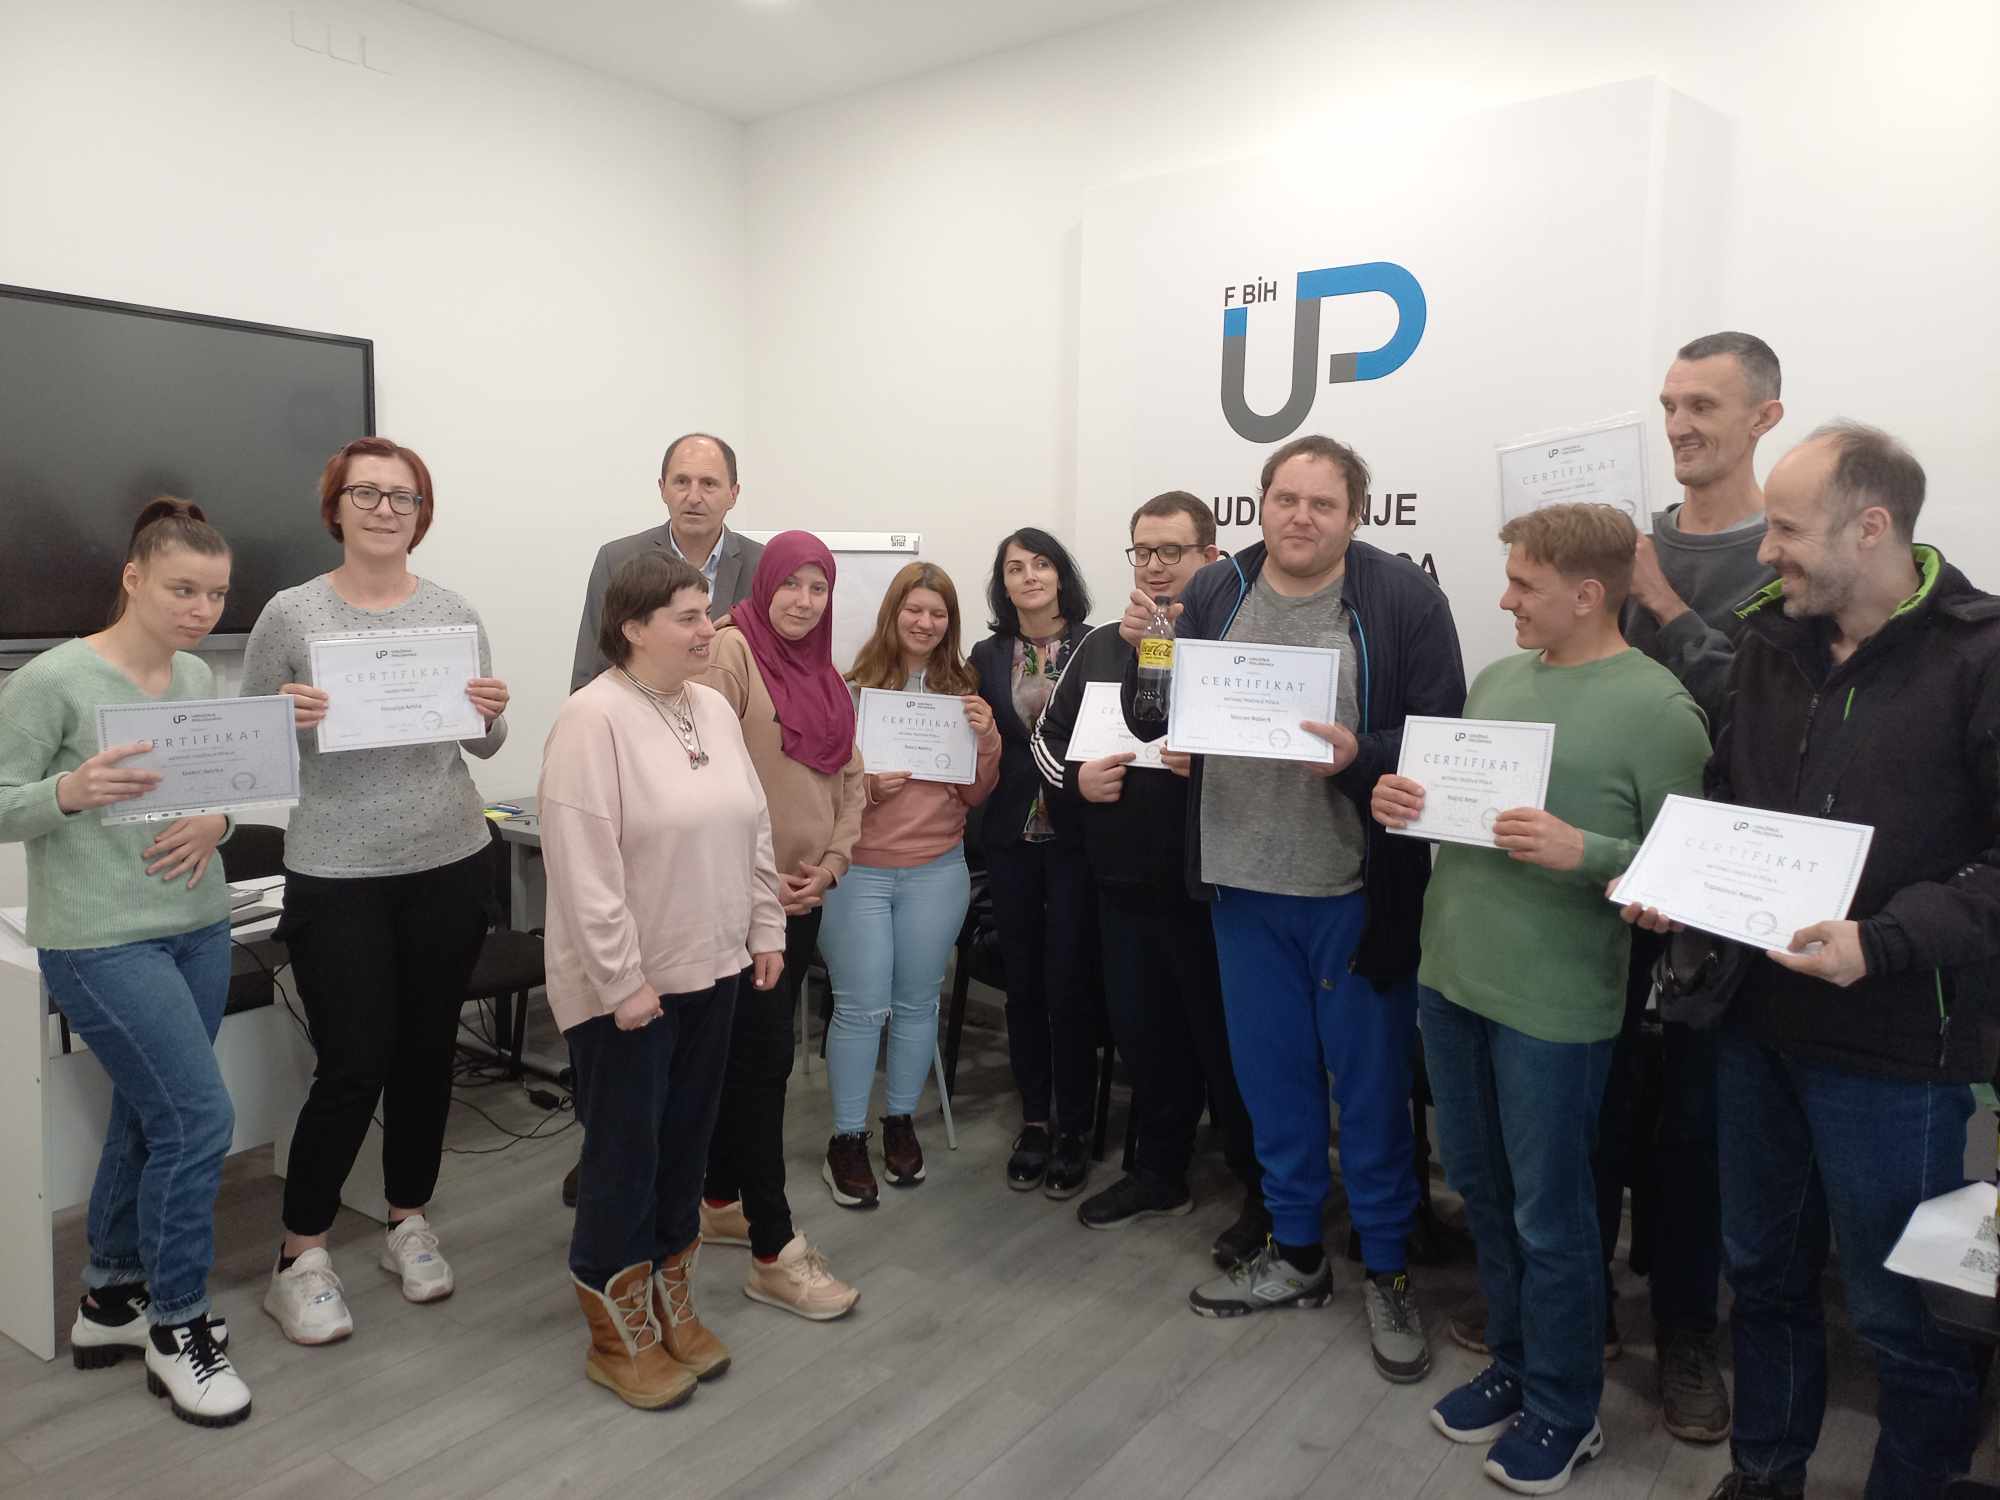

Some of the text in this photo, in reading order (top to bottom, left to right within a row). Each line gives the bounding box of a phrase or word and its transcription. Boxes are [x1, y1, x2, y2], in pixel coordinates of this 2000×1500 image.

[1225, 286, 1236, 306] F
[1221, 261, 1427, 443] UP
[1522, 459, 1617, 485] CERTIFIKAT
[1214, 493, 1417, 526] UDNJE
[344, 667, 450, 684] CERTIFIKAT
[1201, 675, 1306, 692] CERTIFIKAT
[882, 715, 959, 728] CERTIFIKAT
[1424, 753, 1520, 771] CERTIFIKAT
[1685, 838, 1819, 873] CERTIFIKAT
